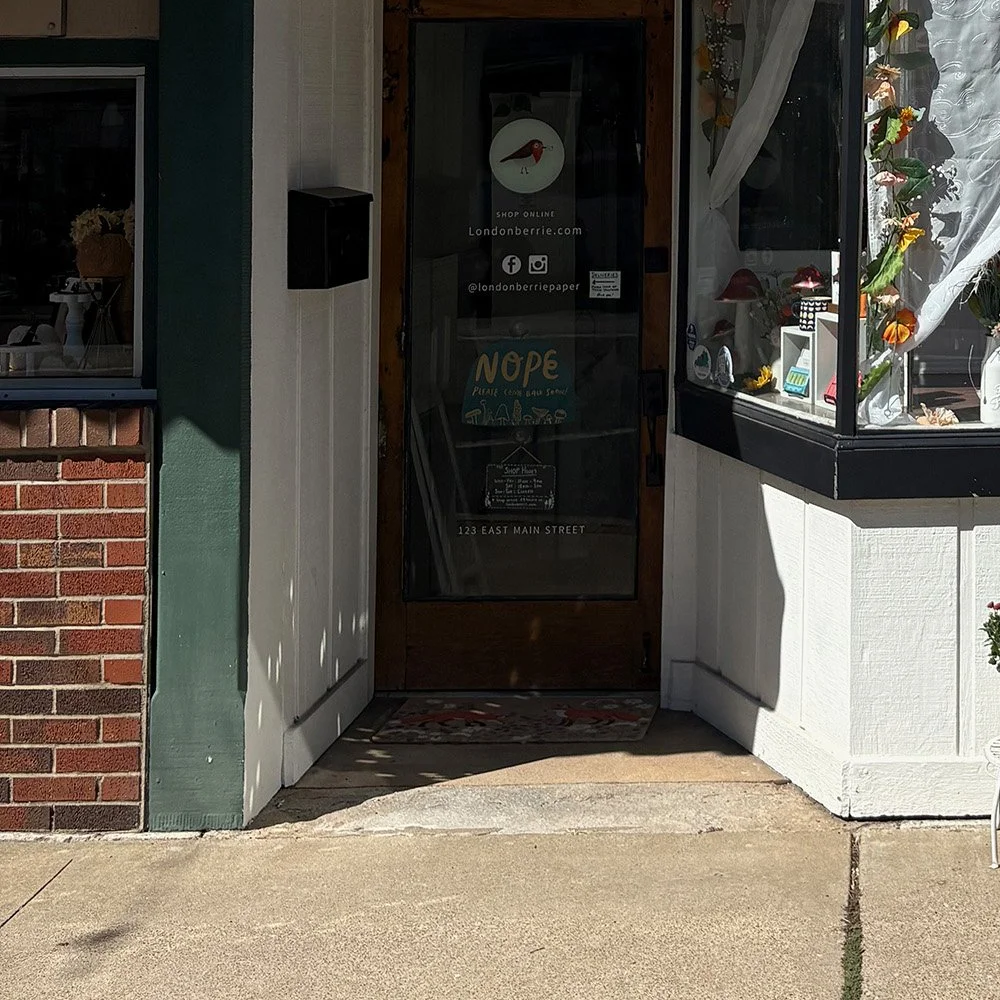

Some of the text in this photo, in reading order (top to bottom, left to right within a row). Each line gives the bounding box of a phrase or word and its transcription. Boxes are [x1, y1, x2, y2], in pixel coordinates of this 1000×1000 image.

[468, 226, 582, 236] Londonberrie.com
[468, 282, 580, 294] @londonberriepaper
[475, 349, 559, 388] NOPE
[458, 525, 586, 535] 123 EAST MAIN STREET
